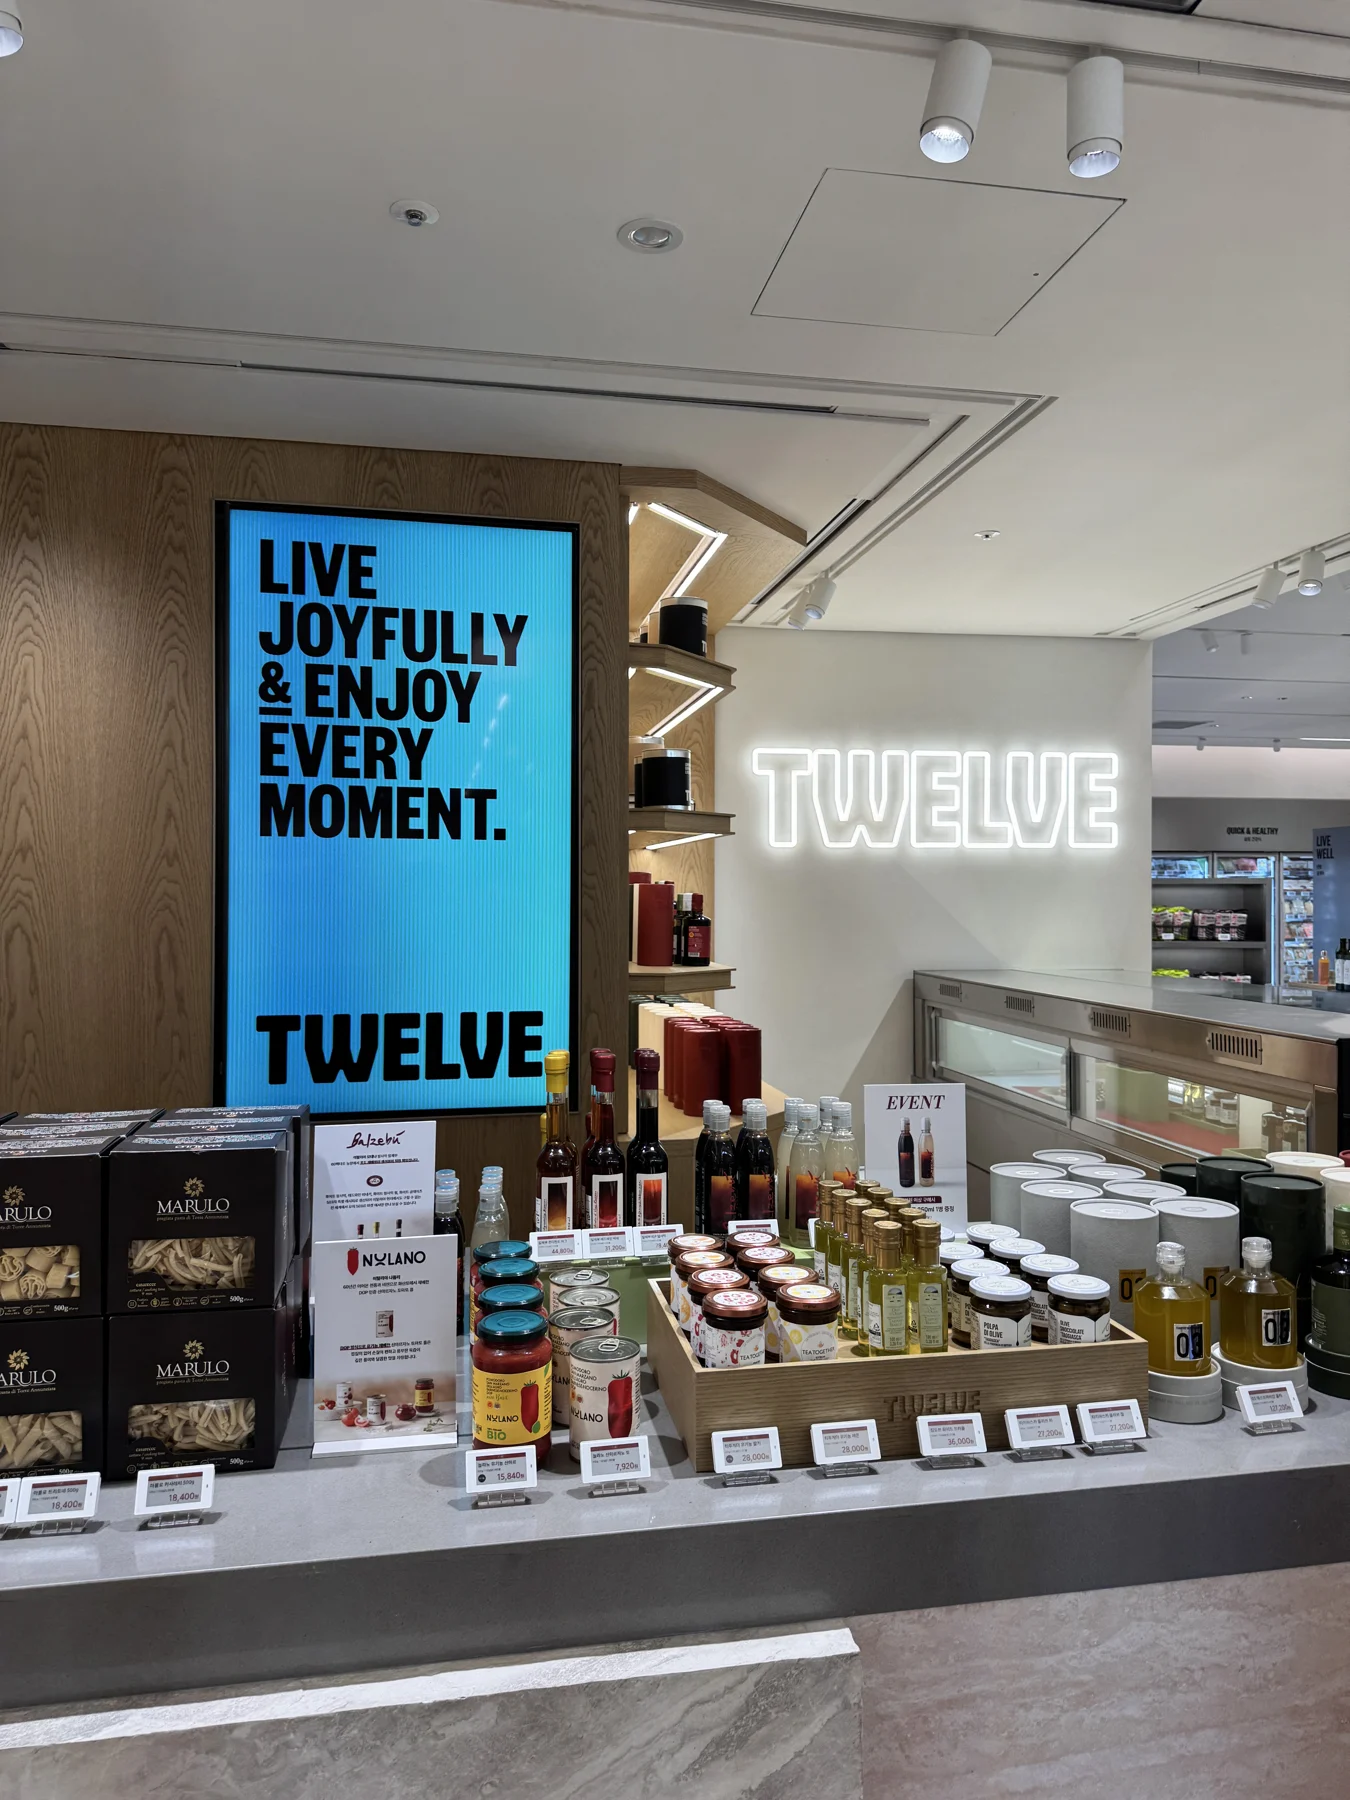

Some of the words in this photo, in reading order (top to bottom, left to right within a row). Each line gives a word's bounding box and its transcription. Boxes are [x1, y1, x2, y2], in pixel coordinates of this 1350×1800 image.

[260, 538, 378, 599] LIVE
[259, 601, 528, 667] JOYFULLY
[258, 661, 293, 705] &
[305, 662, 481, 723] ENJOY
[260, 721, 434, 782] EVERY
[752, 748, 1119, 849] TWELVE
[260, 782, 507, 842] MOMENT.
[1227, 827, 1245, 835] QUICK
[1246, 827, 1251, 835] &
[1252, 827, 1278, 835] HEALTHY
[1316, 836, 1331, 847] LIVE
[1317, 848, 1334, 860] WELL
[256, 1010, 545, 1085] TWELVE
[886, 1094, 946, 1110] EVENT
[157, 1198, 230, 1214] MARULO
[0, 1206, 52, 1223] RULO
[230, 1295, 244, 1303] 500g
[54, 1304, 69, 1312] 500g
[984, 1321, 998, 1330] POLPA
[989, 1330, 1003, 1338] OLIVE
[157, 1360, 230, 1377] MARULO
[0, 1369, 57, 1387] ARULO
[883, 1390, 980, 1421] TWELVE
[487, 1430, 507, 1441] BIO
[230, 1458, 244, 1466] 500g
[52, 1500, 83, 1510] 18,400원
[169, 1492, 200, 1503] 18,400원
